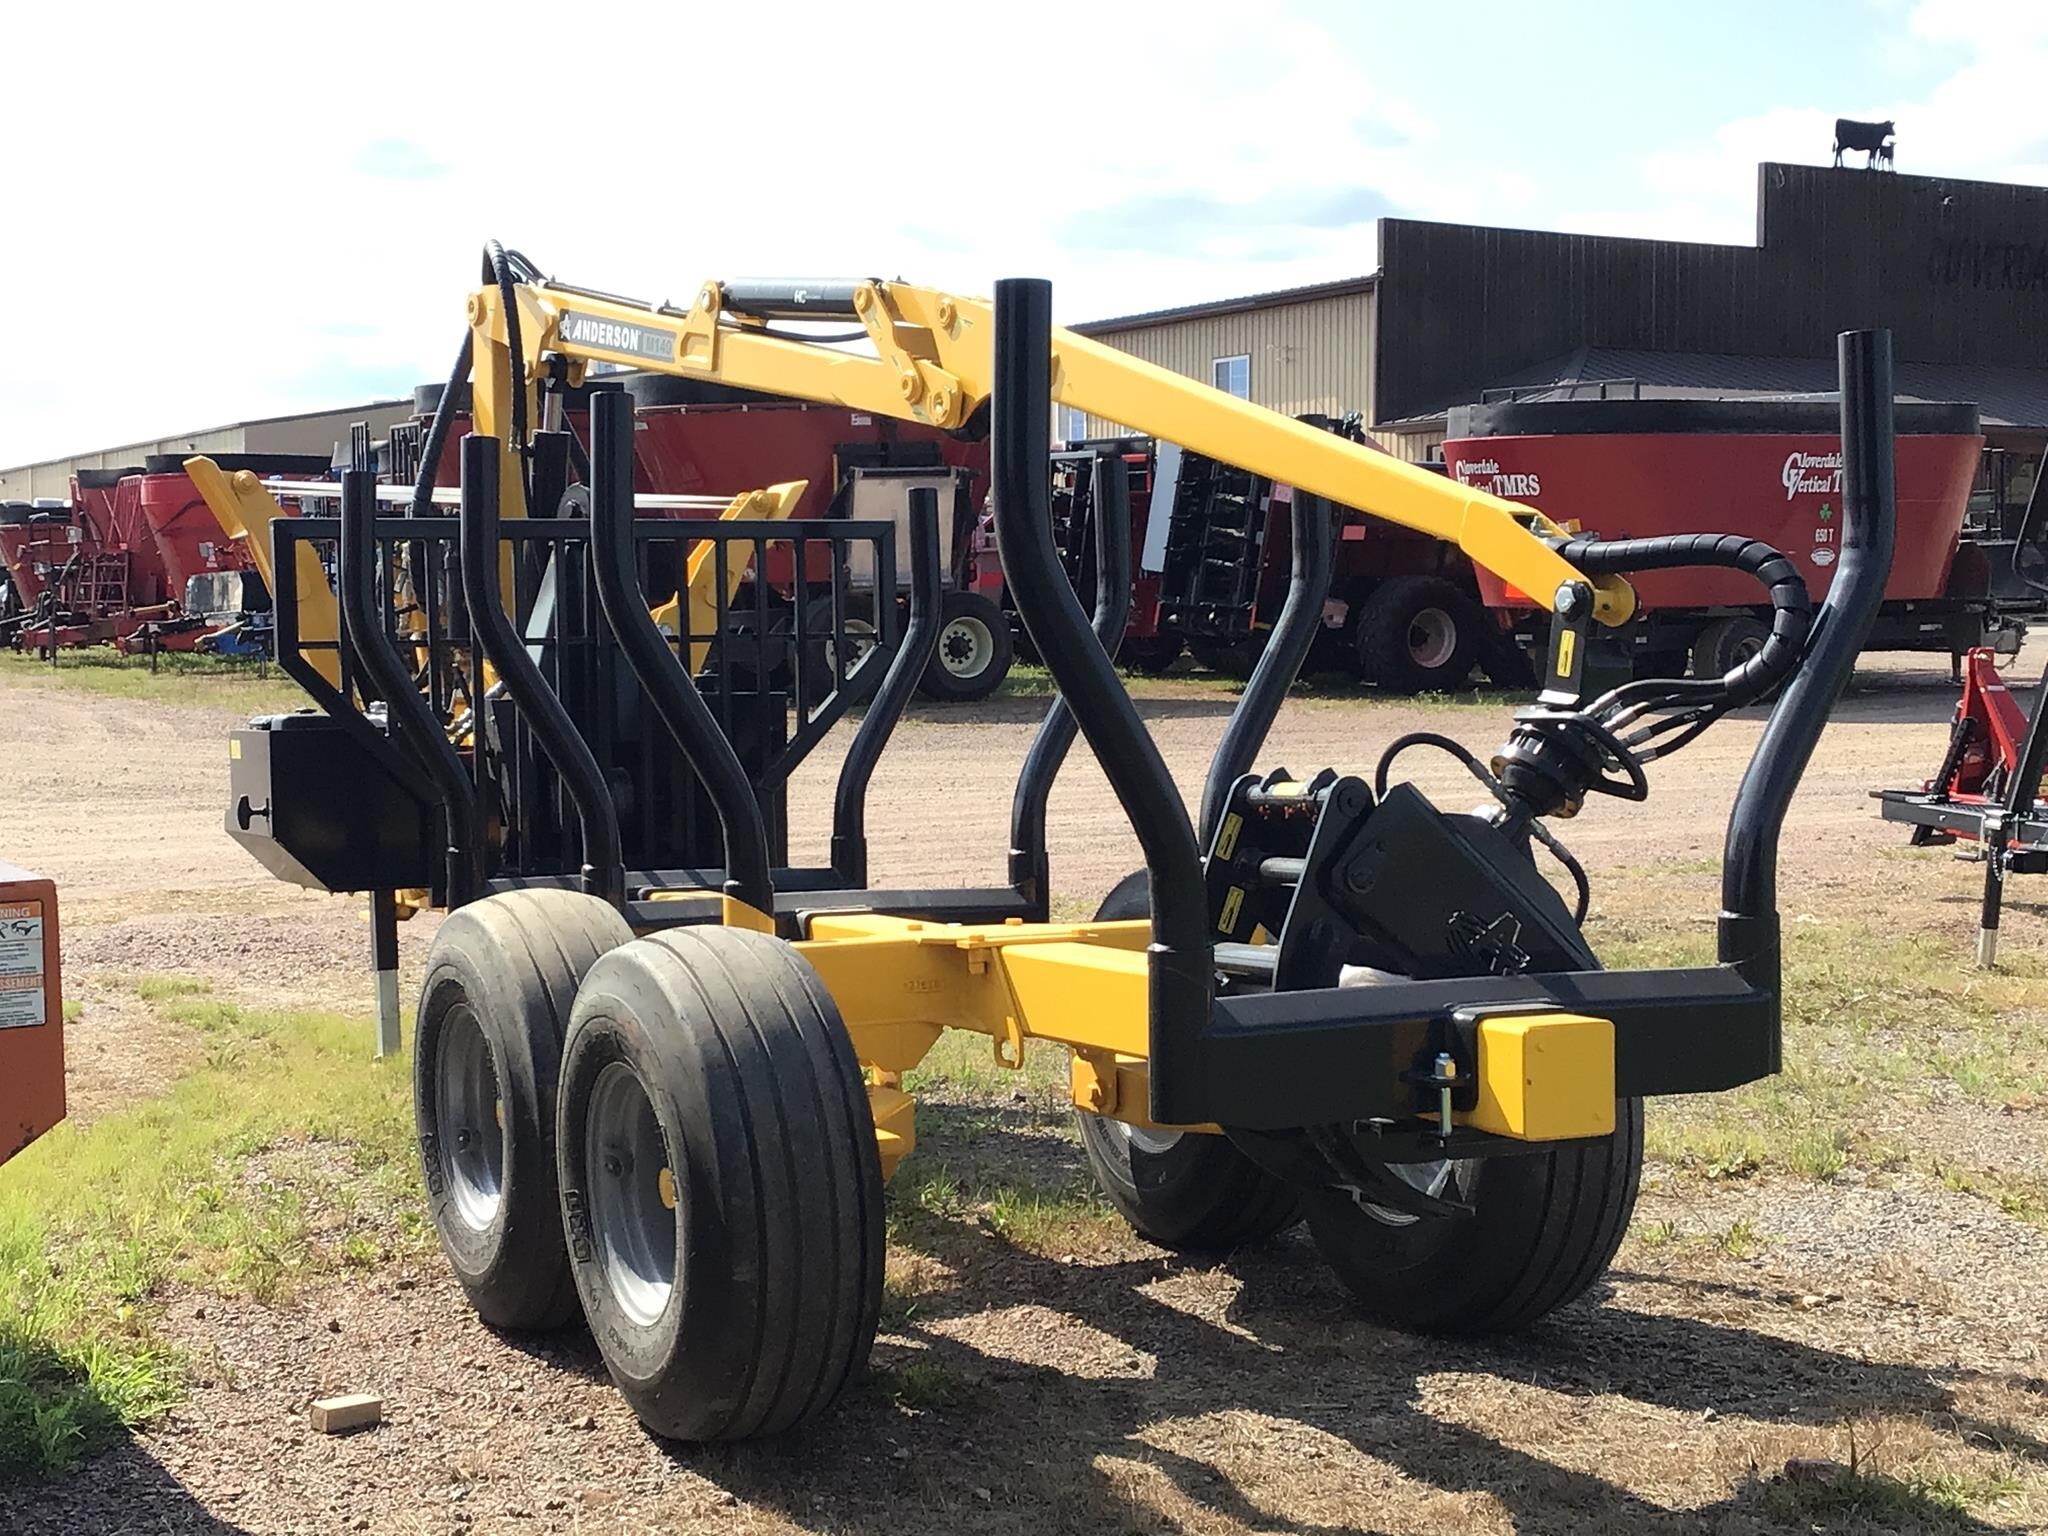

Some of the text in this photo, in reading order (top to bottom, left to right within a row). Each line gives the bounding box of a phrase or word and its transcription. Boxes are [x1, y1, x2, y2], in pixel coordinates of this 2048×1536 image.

[572, 319, 639, 351] ANDERSON
[1493, 474, 1540, 496] TMRS
[1788, 469, 1831, 501] Vertical
[0, 907, 30, 918] NING
